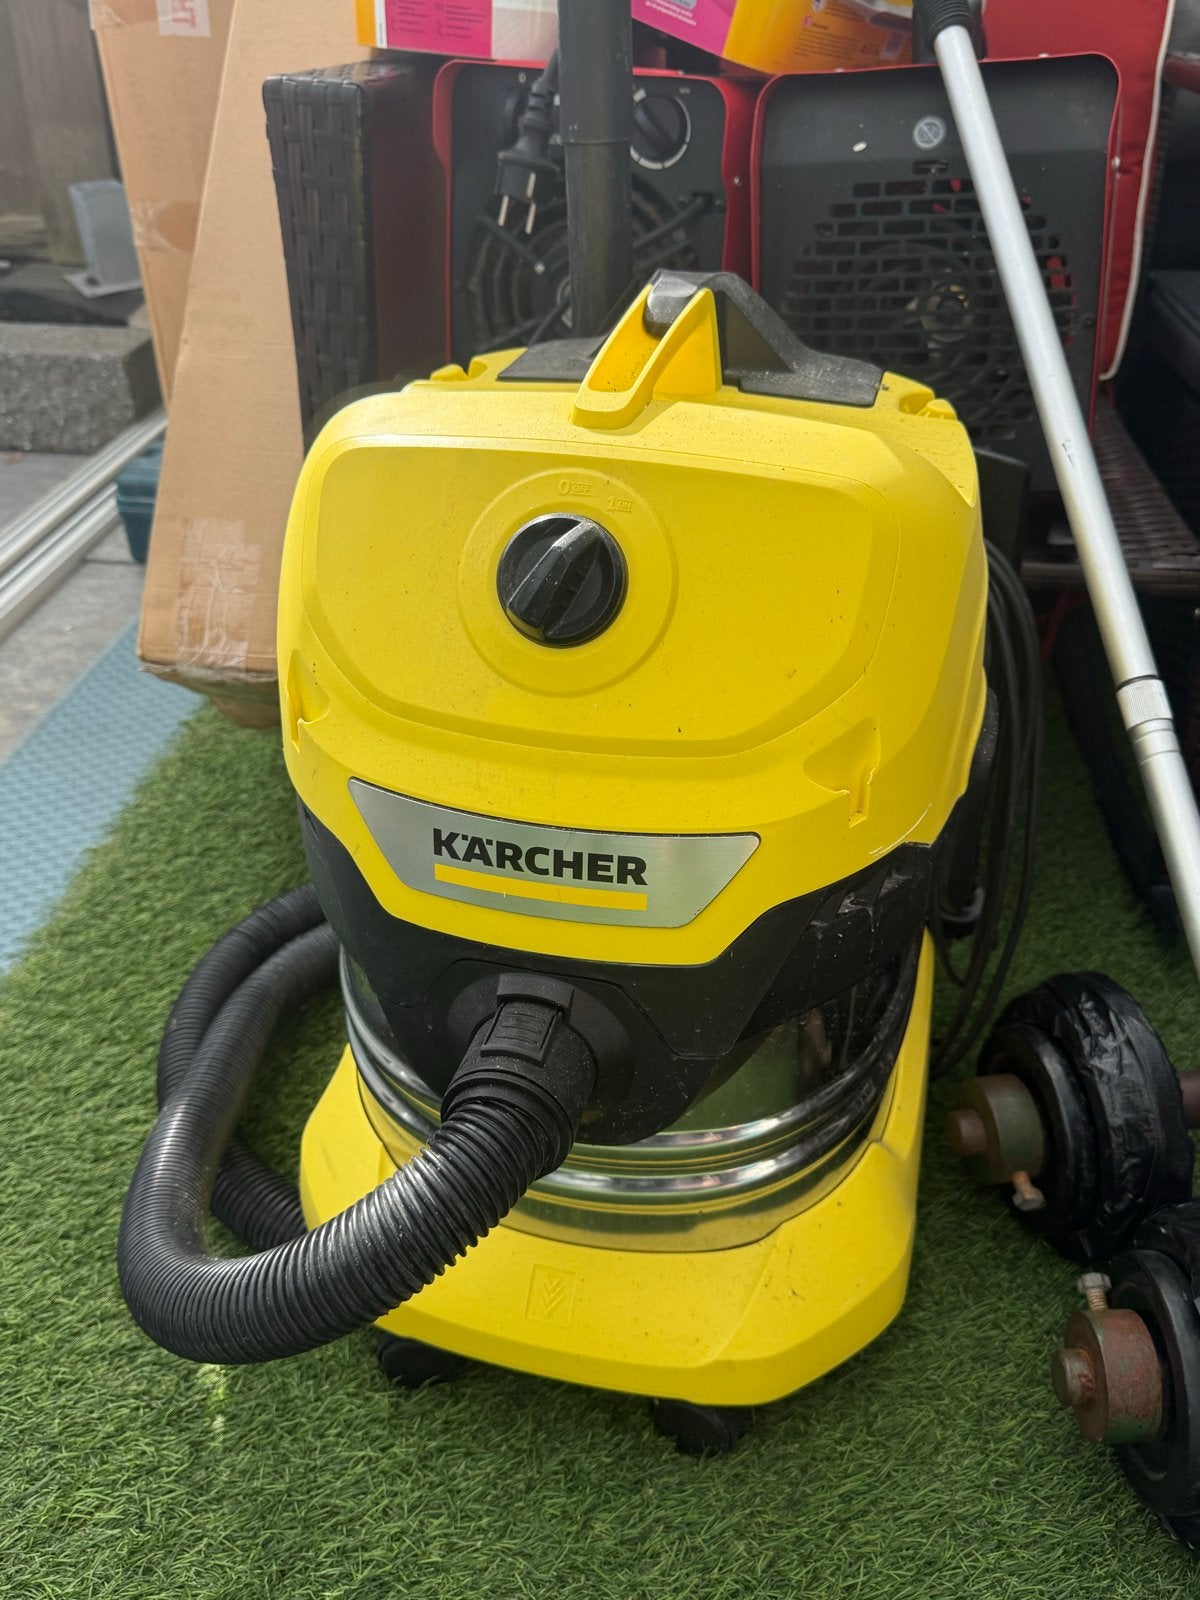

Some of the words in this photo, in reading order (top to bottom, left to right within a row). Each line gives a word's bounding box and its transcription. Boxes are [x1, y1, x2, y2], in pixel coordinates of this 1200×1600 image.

[572, 483, 592, 495] OFF
[616, 500, 632, 511] ON
[432, 827, 648, 886] KÄRCHER
